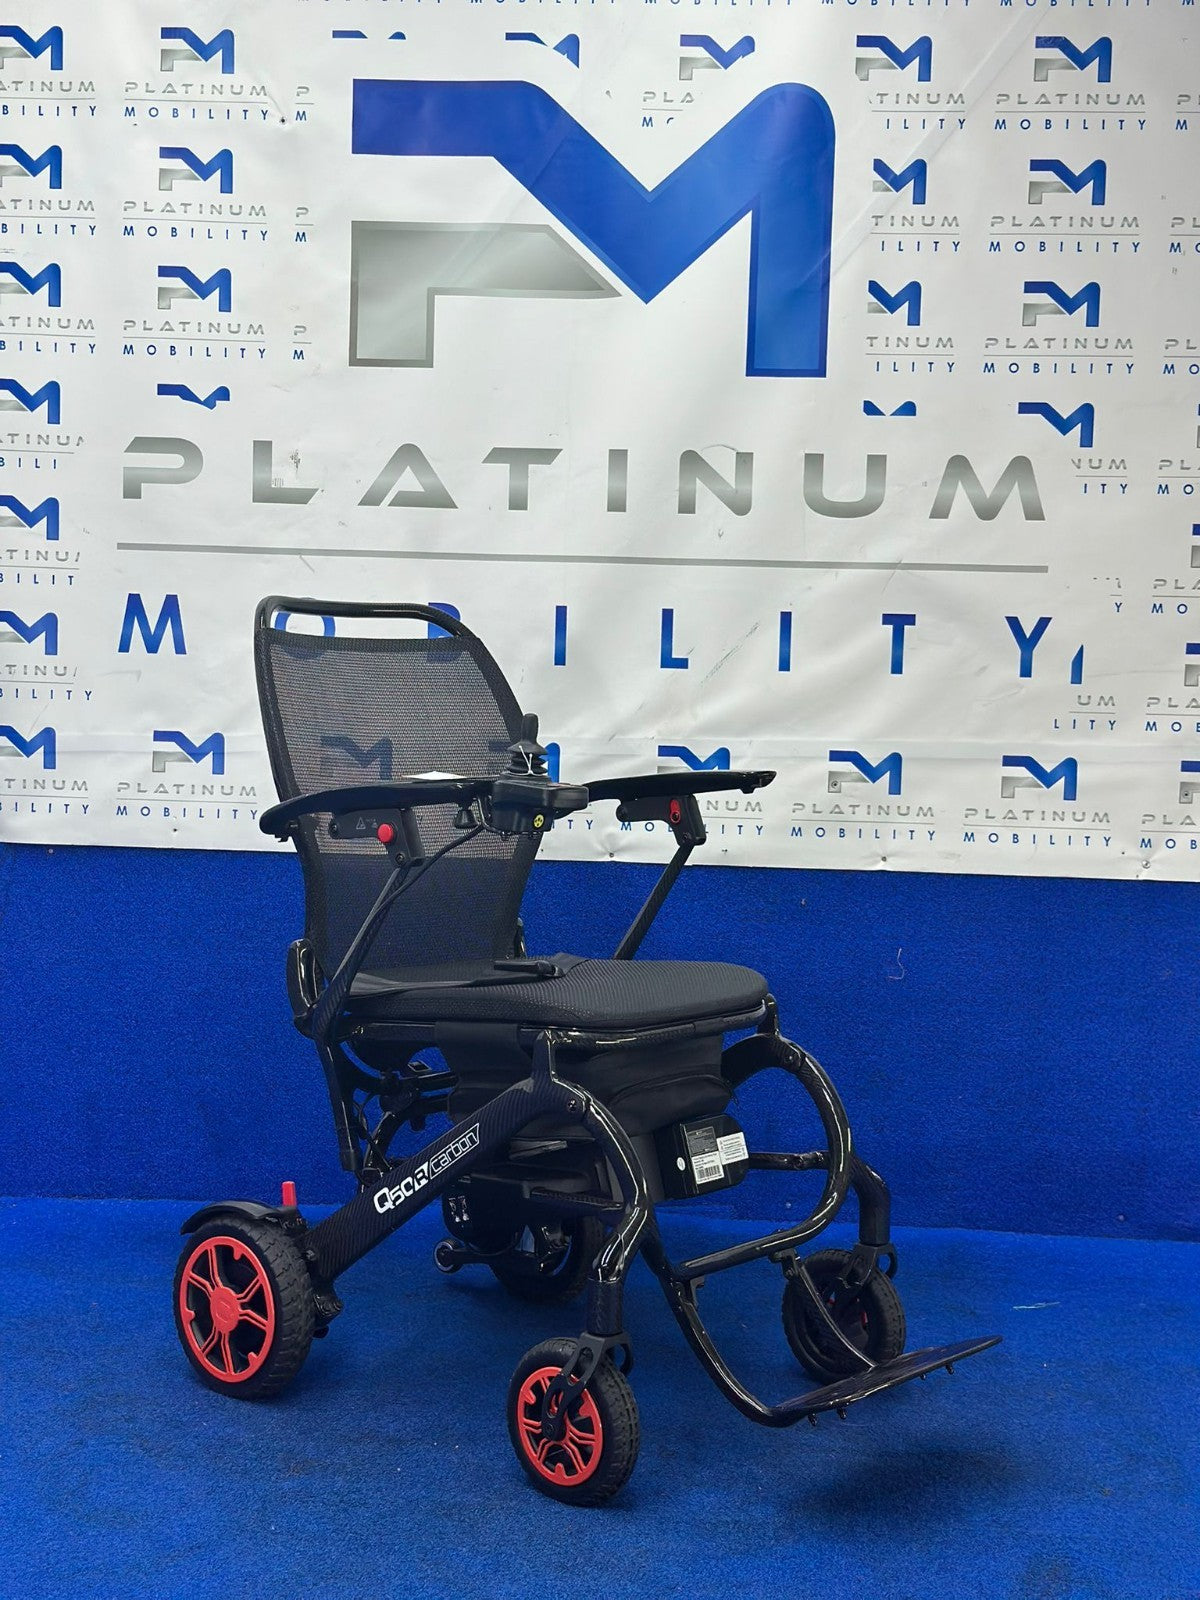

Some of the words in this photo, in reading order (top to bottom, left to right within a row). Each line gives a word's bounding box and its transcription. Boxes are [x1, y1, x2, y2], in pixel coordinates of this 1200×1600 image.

[123, 81, 268, 97] PLATINUM
[996, 93, 1145, 107] PLATINUM
[124, 106, 268, 120] MOBILITY
[995, 119, 1147, 130] MOBILITY
[122, 201, 267, 217] PLATINUM
[991, 216, 1140, 229] PLATINUM
[123, 225, 268, 241] MOBILITY
[989, 241, 1140, 253] MOBILITY
[123, 320, 265, 336] PLATINUM
[985, 336, 1134, 350] PLATINUM
[123, 344, 266, 359] MOBILITY
[983, 362, 1136, 374] MOBILITY
[123, 436, 1046, 520] PLATINUM
[117, 782, 256, 796] PLATINUM
[116, 805, 258, 820] MOBILITY
[792, 802, 934, 818] PLATINUM
[963, 808, 1110, 824] PLATINUM
[791, 826, 936, 841] MOBILITY
[963, 832, 1112, 847] MOBILITY
[431, 1131, 478, 1173] carbon
